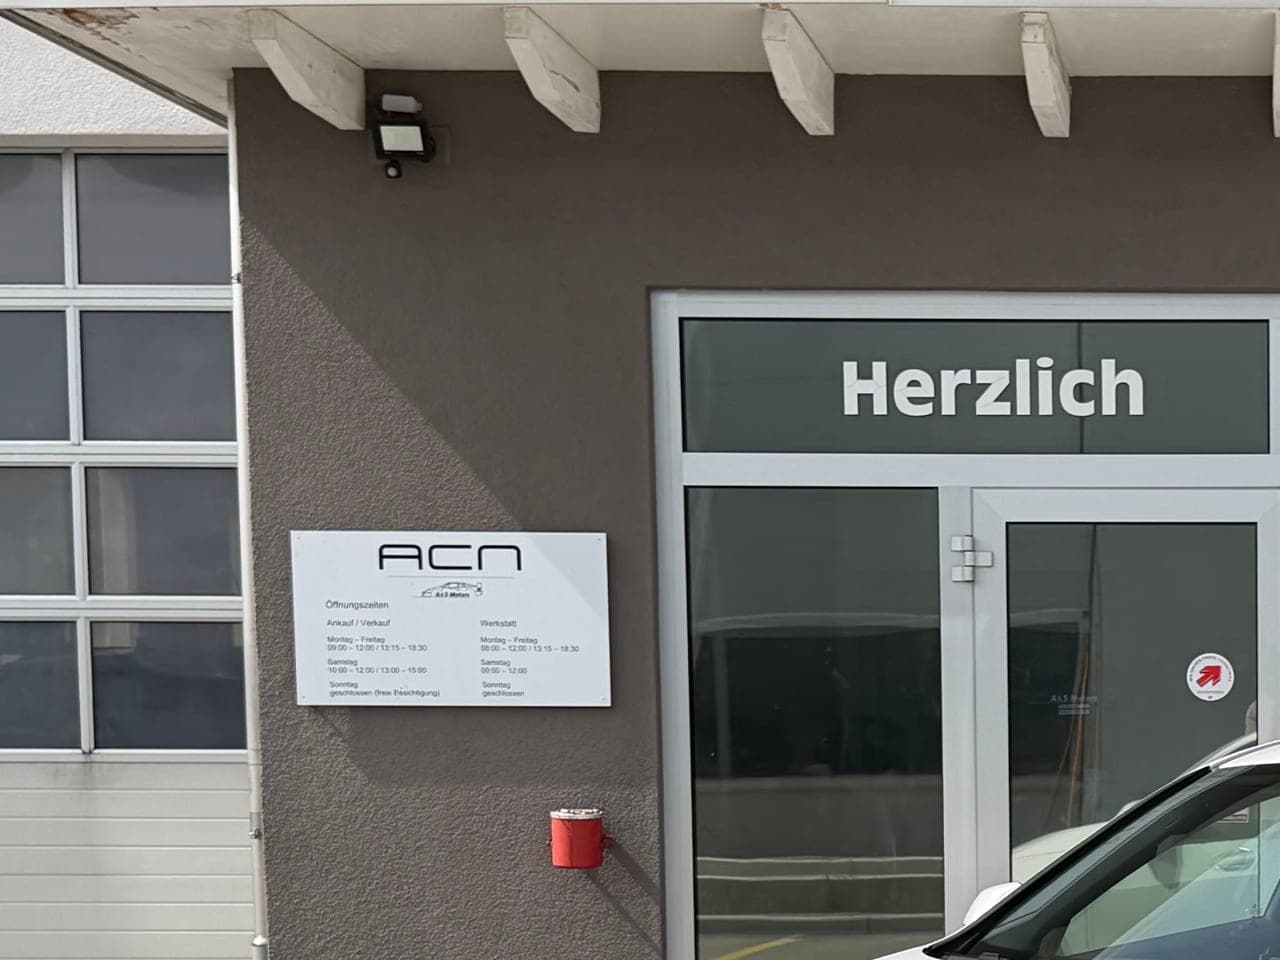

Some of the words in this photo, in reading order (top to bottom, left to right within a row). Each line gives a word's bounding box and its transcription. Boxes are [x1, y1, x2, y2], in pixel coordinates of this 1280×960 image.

[843, 357, 1145, 417] Herzlich
[379, 544, 522, 571] ACN
[325, 599, 389, 609] Öffnungszeiten
[327, 619, 354, 627] Ankauf
[360, 619, 390, 627] Verkauf
[480, 619, 517, 627] Werkstatt
[327, 636, 353, 644] Montag
[361, 636, 385, 644] Freitag
[514, 637, 538, 645] Freitag
[328, 659, 358, 667] Samstag
[480, 659, 511, 667] Samstag
[329, 681, 358, 689] Sonntag
[482, 681, 511, 689] Sonntag
[329, 690, 372, 698] geschlossen
[482, 690, 525, 698] geschlossen
